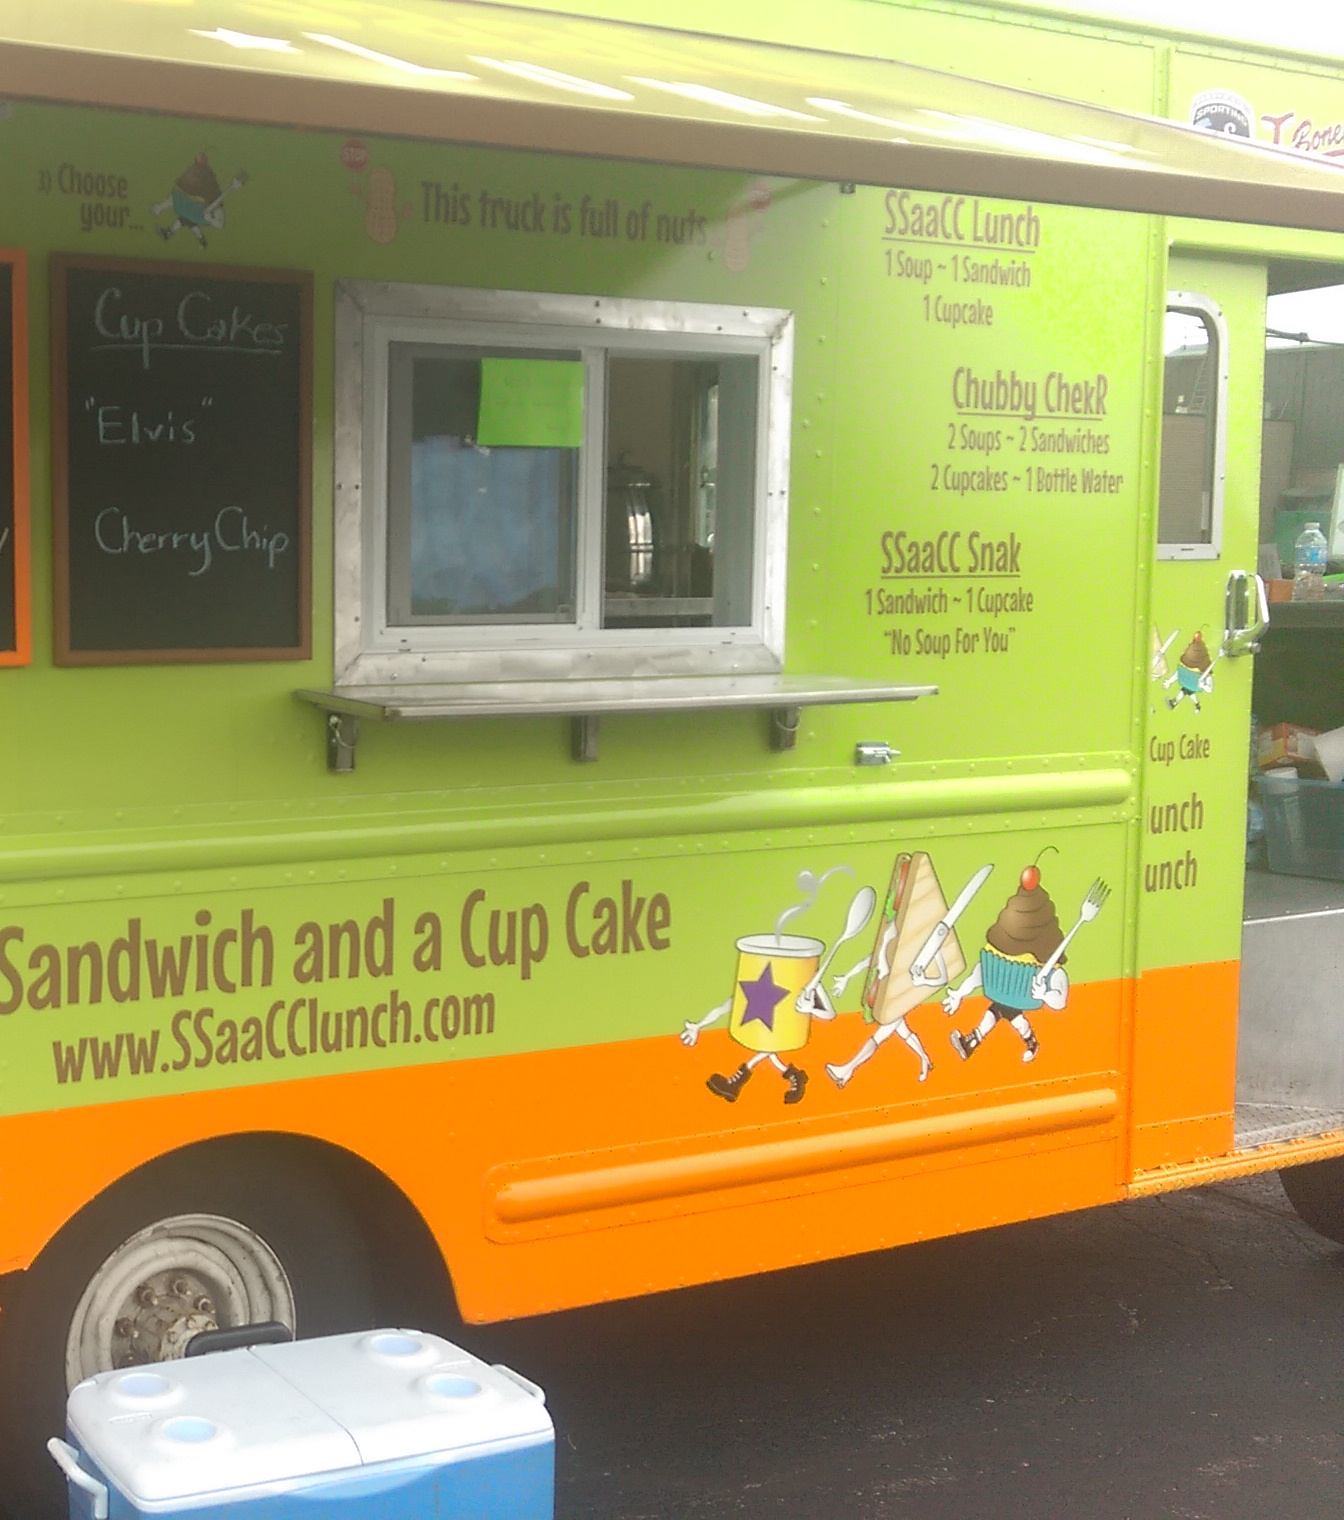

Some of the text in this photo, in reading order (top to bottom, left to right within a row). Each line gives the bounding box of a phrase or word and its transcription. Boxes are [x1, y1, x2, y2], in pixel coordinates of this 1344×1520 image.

[37, 162, 129, 199] 3) Choose
[421, 179, 707, 245] This truck is full of nuts
[885, 190, 1040, 247] SSaaCC Lunch
[885, 250, 892, 276] 1
[897, 250, 933, 284] Soup
[951, 254, 958, 280] 1
[963, 255, 1032, 288] Sandwich
[94, 288, 289, 369] Cup Cakes
[923, 294, 994, 328] 1 Cupcake
[953, 366, 1109, 421] Chubby ChekR
[948, 423, 956, 450] 2
[961, 424, 1002, 456] Soups
[1019, 426, 1027, 452] 2
[1031, 426, 1110, 455] Sandwiches
[931, 463, 939, 491] 2
[943, 464, 1008, 496] Cupcakes
[1026, 466, 1032, 491] 1
[1037, 466, 1077, 493] Bottle
[1082, 468, 1124, 495] Water
[94, 506, 290, 576] Cherry Chip
[881, 530, 1021, 574] SSaaCC Snak
[865, 588, 873, 615] 1
[877, 586, 948, 615] Sandwich
[967, 587, 973, 612] 1
[977, 587, 1034, 617] Cupcake
[915, 629, 951, 659] Soup
[956, 628, 979, 653] For
[1150, 733, 1210, 767] Cup Cake
[1146, 792, 1204, 834] unch
[292, 896, 396, 985] and
[413, 911, 442, 974] a
[460, 888, 550, 980] Cup
[565, 880, 672, 958] Cake
[52, 986, 497, 1085] www.SSaaCClunch.com
